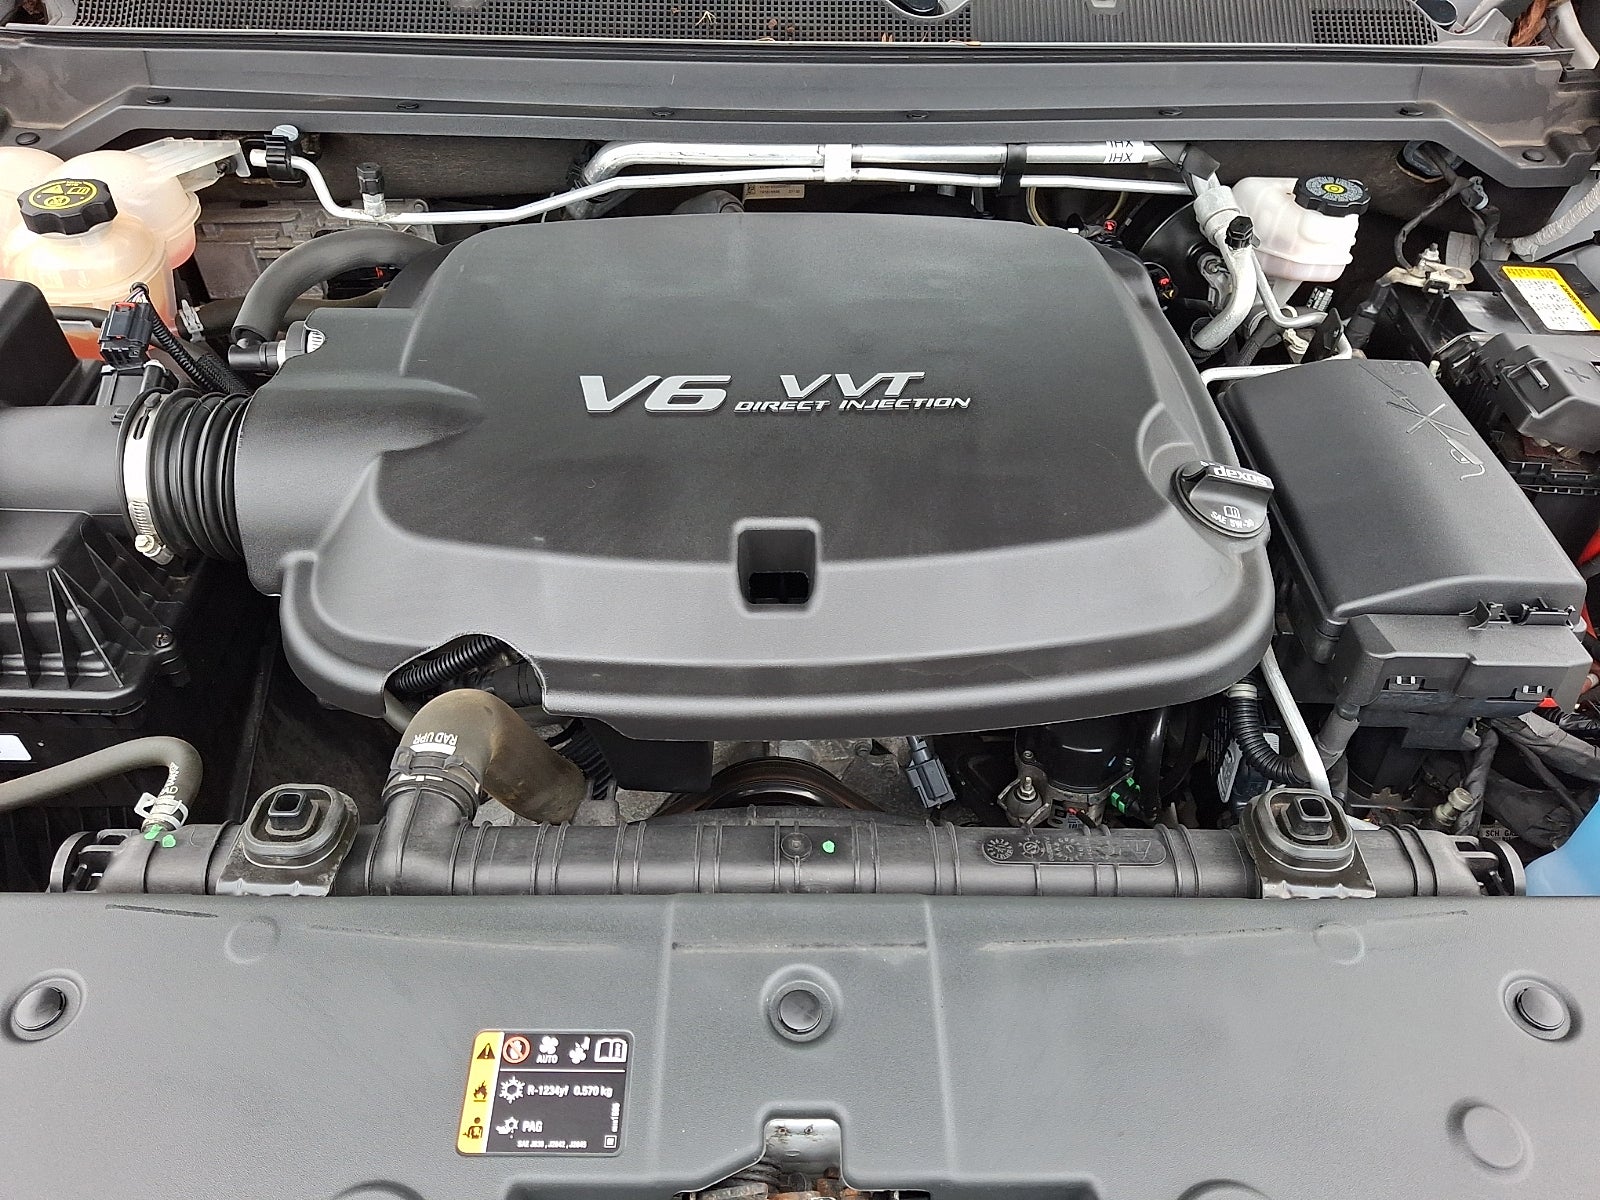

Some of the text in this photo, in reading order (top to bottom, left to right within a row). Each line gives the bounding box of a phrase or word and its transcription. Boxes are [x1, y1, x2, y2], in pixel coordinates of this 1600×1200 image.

[1109, 153, 1133, 162] IHX
[779, 371, 926, 398] VVT
[579, 374, 733, 413] V6
[734, 396, 972, 414] DIRECT INJECTION
[1213, 466, 1267, 486] dexos
[1210, 511, 1228, 525] SAE
[413, 732, 458, 746] RAD UPR
[1485, 829, 1500, 837] SCH
[536, 1054, 559, 1064] AUTO
[527, 1085, 614, 1099] R-1234yf 0.570 kg
[522, 1120, 543, 1133] PAG
